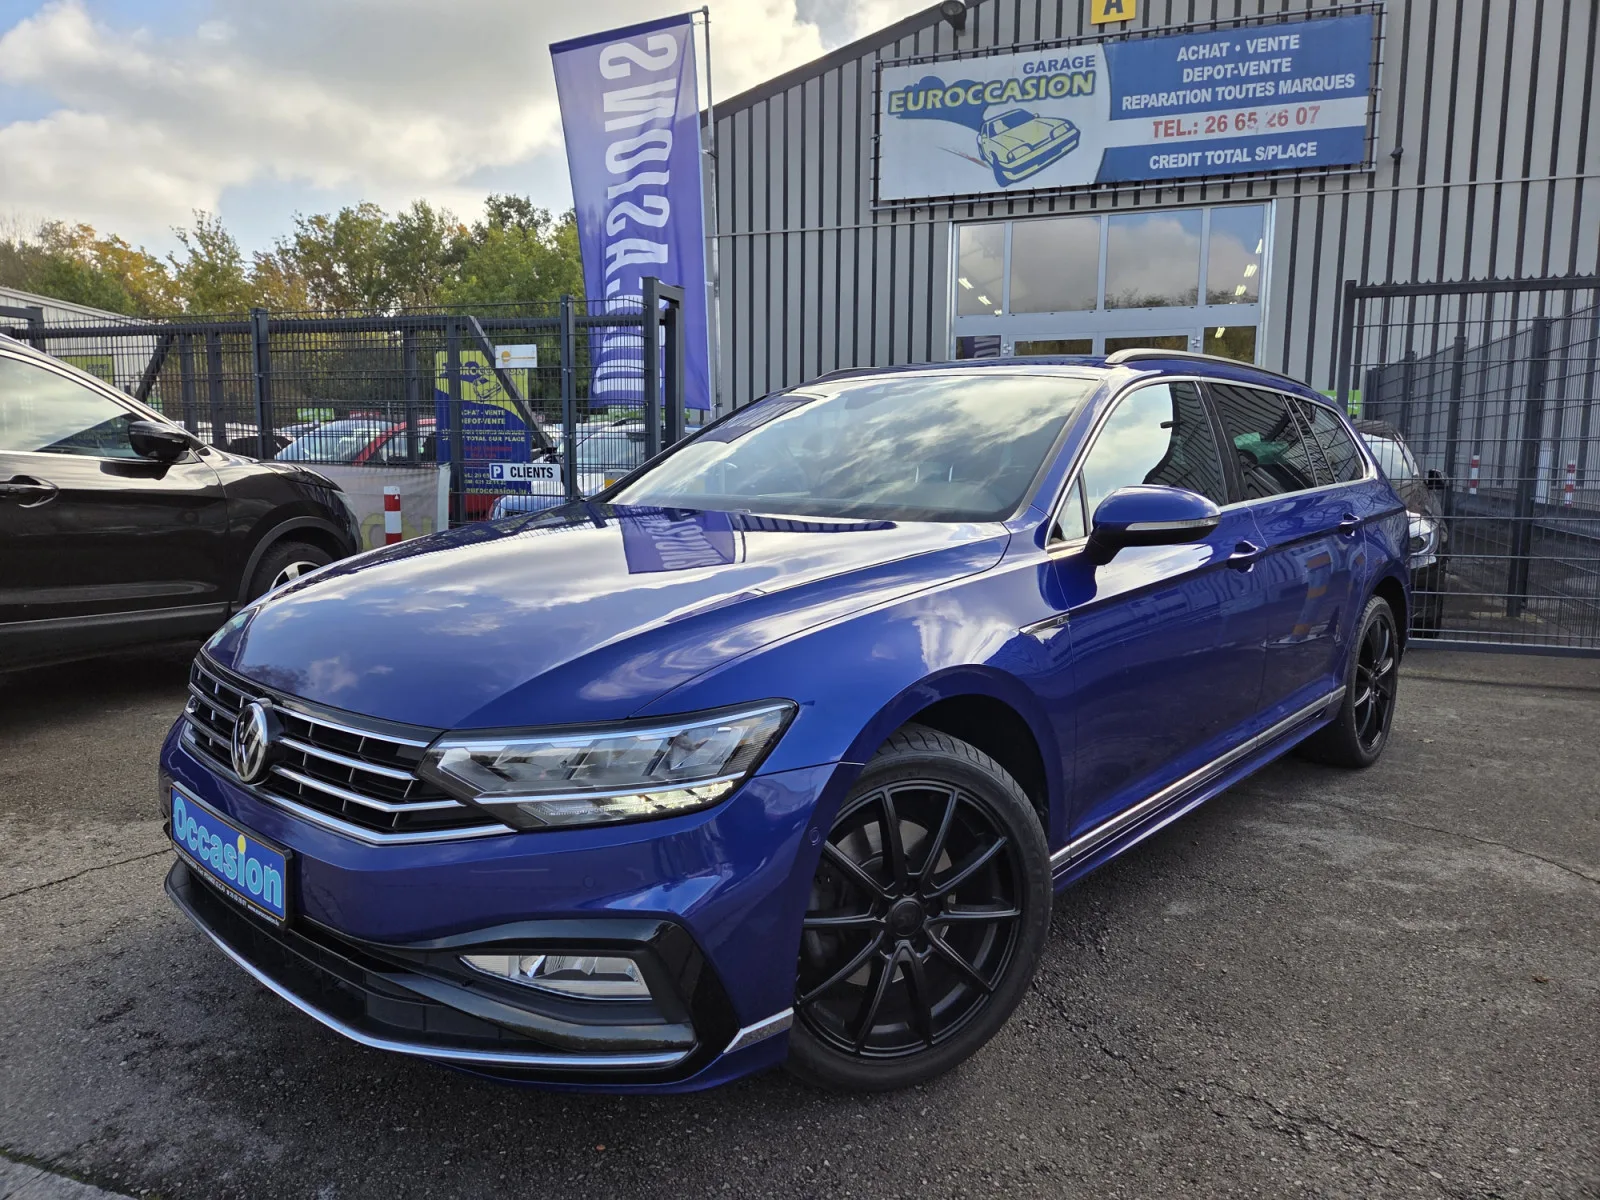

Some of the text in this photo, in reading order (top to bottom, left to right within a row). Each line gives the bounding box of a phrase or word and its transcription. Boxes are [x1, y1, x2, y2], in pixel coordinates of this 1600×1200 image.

[1177, 34, 1300, 62] ACHAT VENTE
[1022, 55, 1096, 75] GARAGE
[1183, 57, 1292, 83] DEPOT-VENTE
[888, 70, 1097, 115] EUROCCASION
[1122, 73, 1356, 111] REPARATION TOUTES MARQUES
[1153, 120, 1198, 138] TEL.:
[1205, 115, 1228, 134] 26
[1234, 112, 1258, 131] 65
[1296, 105, 1321, 126] 07
[1150, 141, 1318, 170] CREDIT TOTAL S/PLACE
[510, 466, 554, 479] CLIENTS
[173, 796, 282, 909] Occasion
